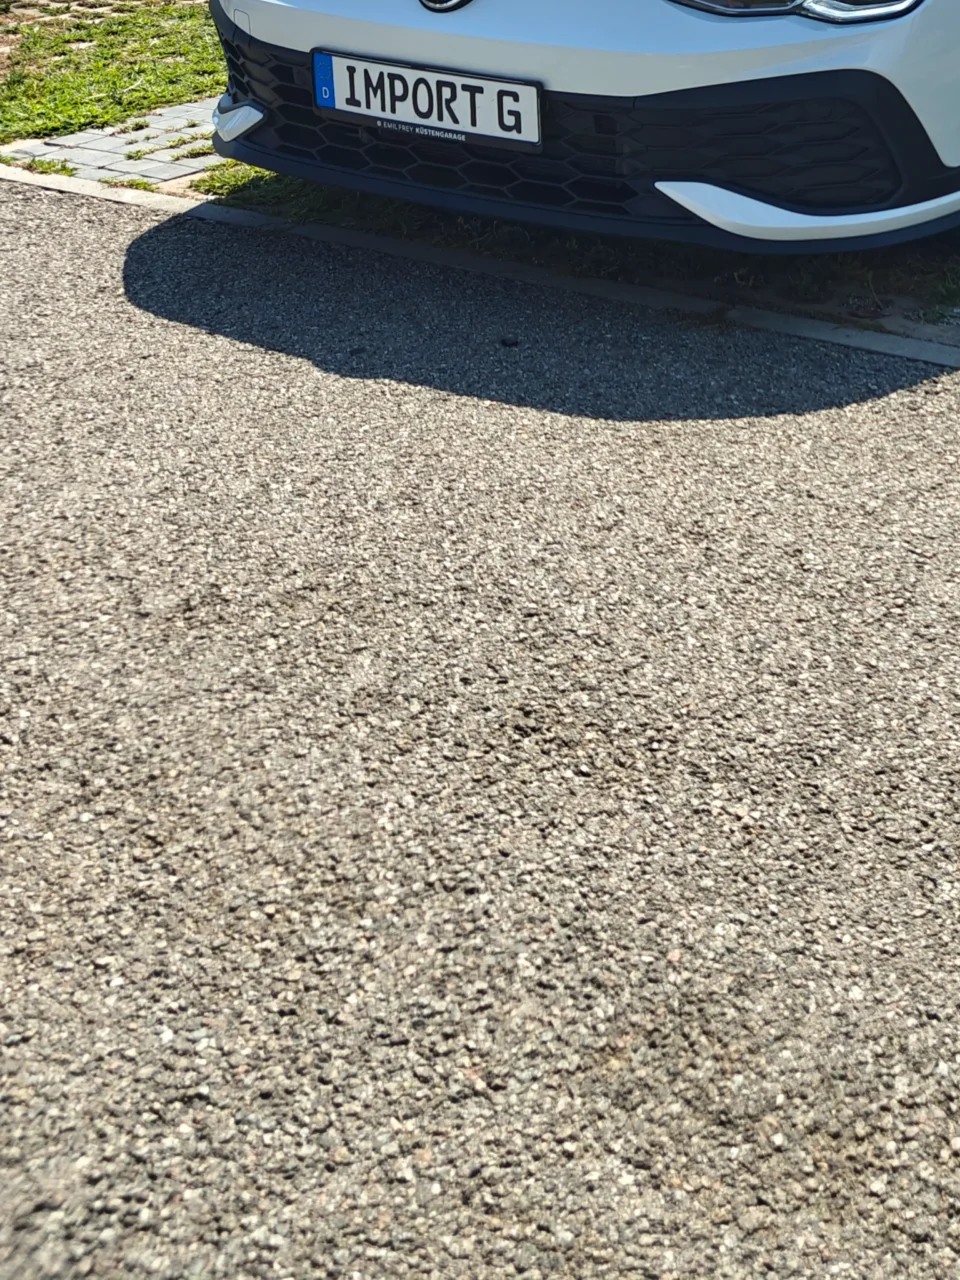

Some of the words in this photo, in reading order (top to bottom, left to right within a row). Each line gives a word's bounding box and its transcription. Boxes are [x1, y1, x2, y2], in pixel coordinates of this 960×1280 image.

[322, 86, 330, 98] D
[345, 65, 484, 128] IMPORT
[497, 89, 522, 134] G
[415, 126, 466, 141] KÜSTENGARAGE
